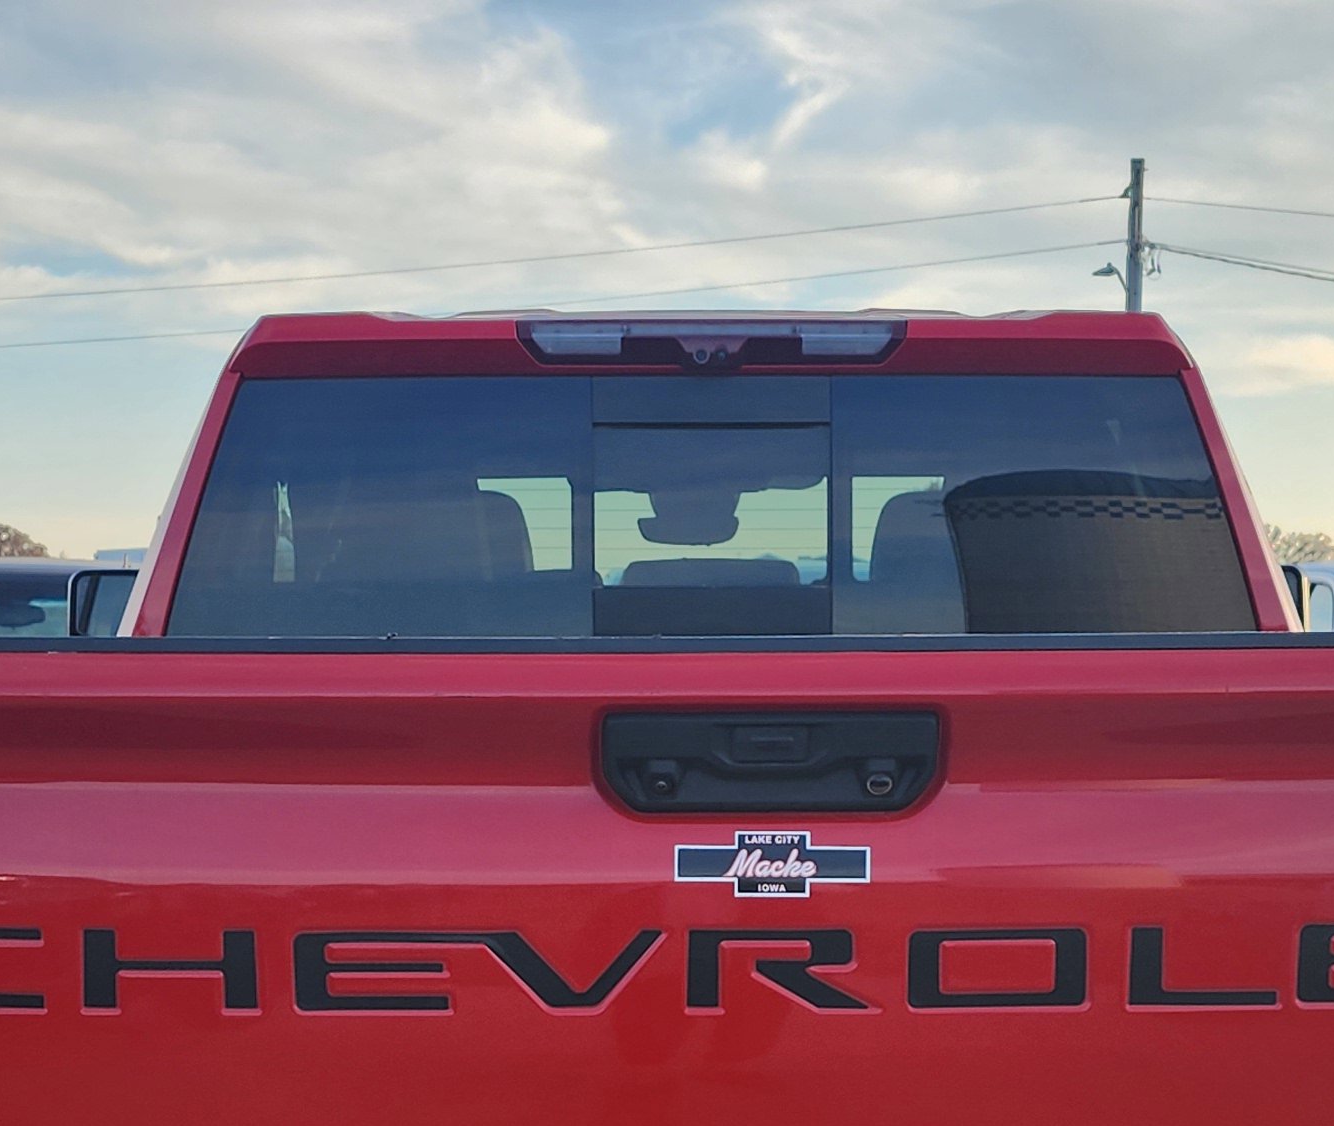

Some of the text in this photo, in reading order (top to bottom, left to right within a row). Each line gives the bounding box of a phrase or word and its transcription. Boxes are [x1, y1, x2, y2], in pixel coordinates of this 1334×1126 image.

[744, 835, 800, 844] LAKE CITY
[723, 848, 817, 878] Macke
[757, 884, 786, 892] IOWA
